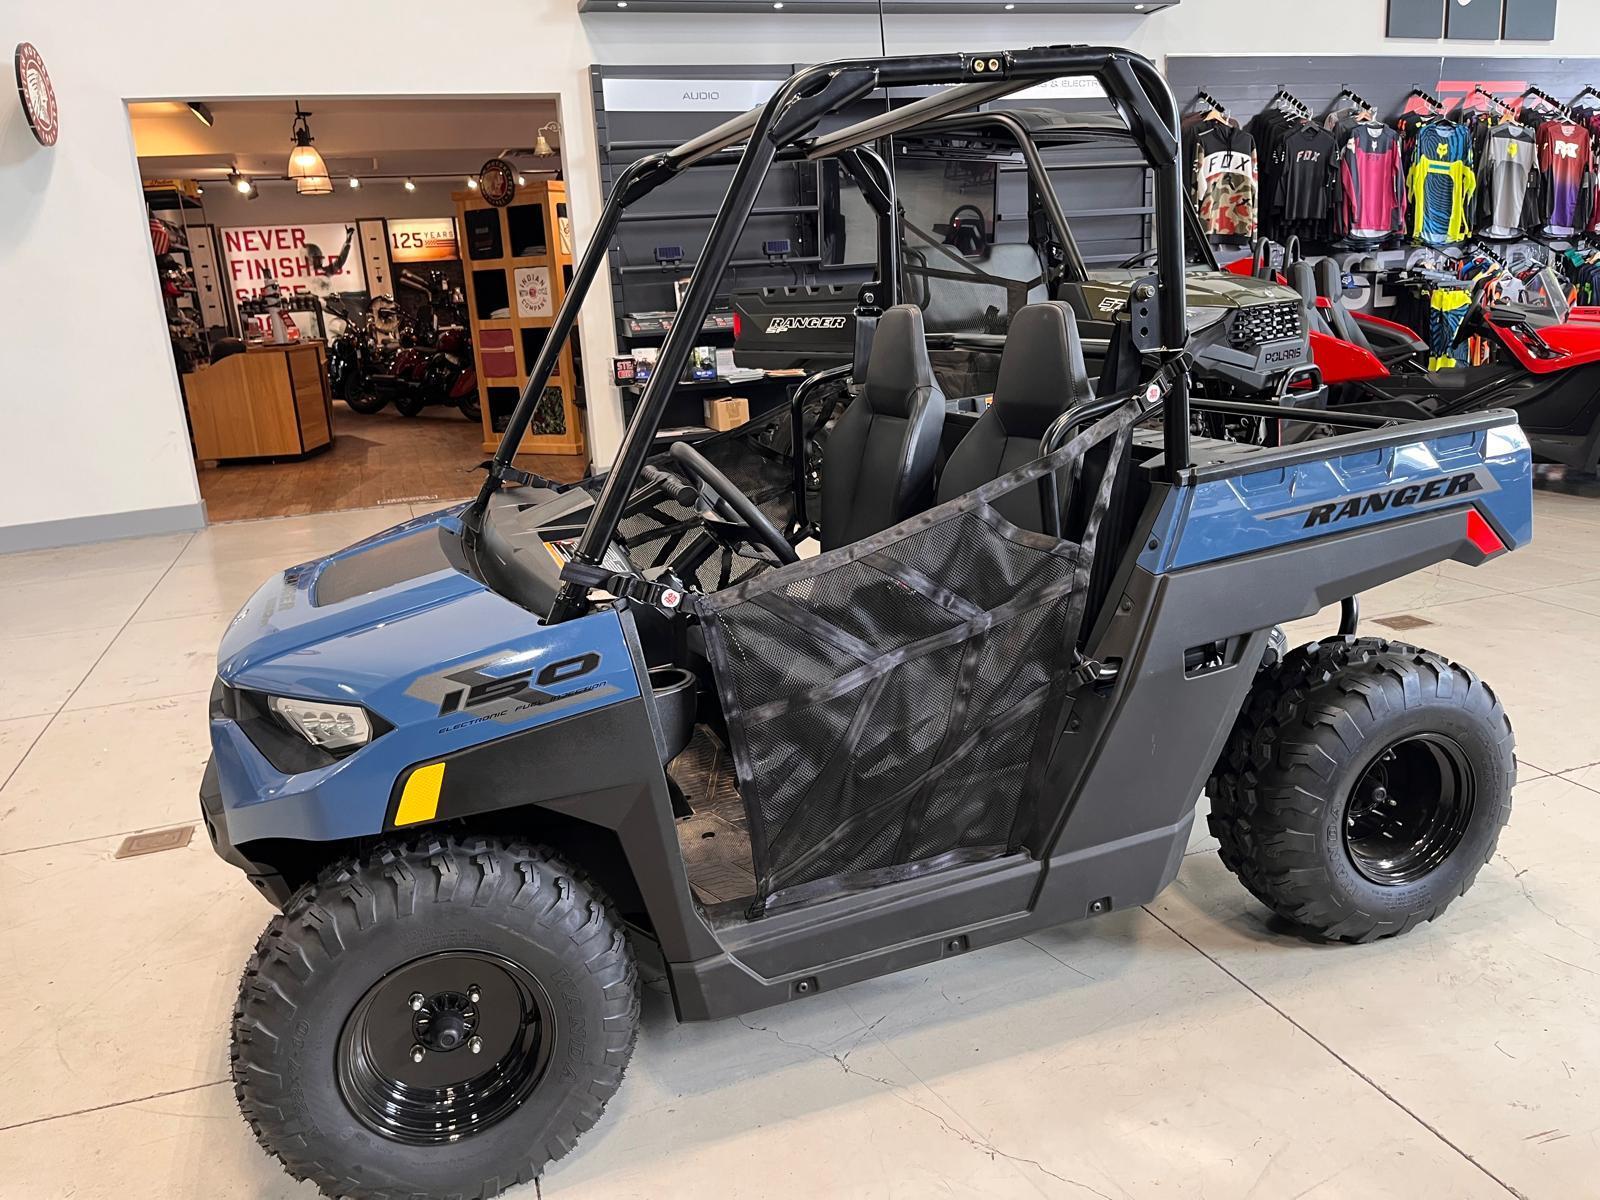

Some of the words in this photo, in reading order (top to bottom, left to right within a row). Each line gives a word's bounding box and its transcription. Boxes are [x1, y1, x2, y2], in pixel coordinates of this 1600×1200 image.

[1050, 79, 1059, 88] &
[682, 91, 720, 101] AUDIO
[1209, 153, 1250, 173] FOX
[1296, 149, 1321, 163] FOX
[225, 228, 307, 253] NEVER
[392, 232, 424, 249] 125
[424, 230, 454, 240] YEARS
[765, 326, 788, 334] SP
[769, 317, 847, 329] RANGER
[1264, 347, 1302, 364] POLARIS
[1302, 472, 1477, 529] RANGER
[437, 652, 602, 718] 150
[437, 709, 508, 735] ELECTRONIC
[515, 699, 546, 712] FUEL
[550, 680, 607, 703] INJECTION
